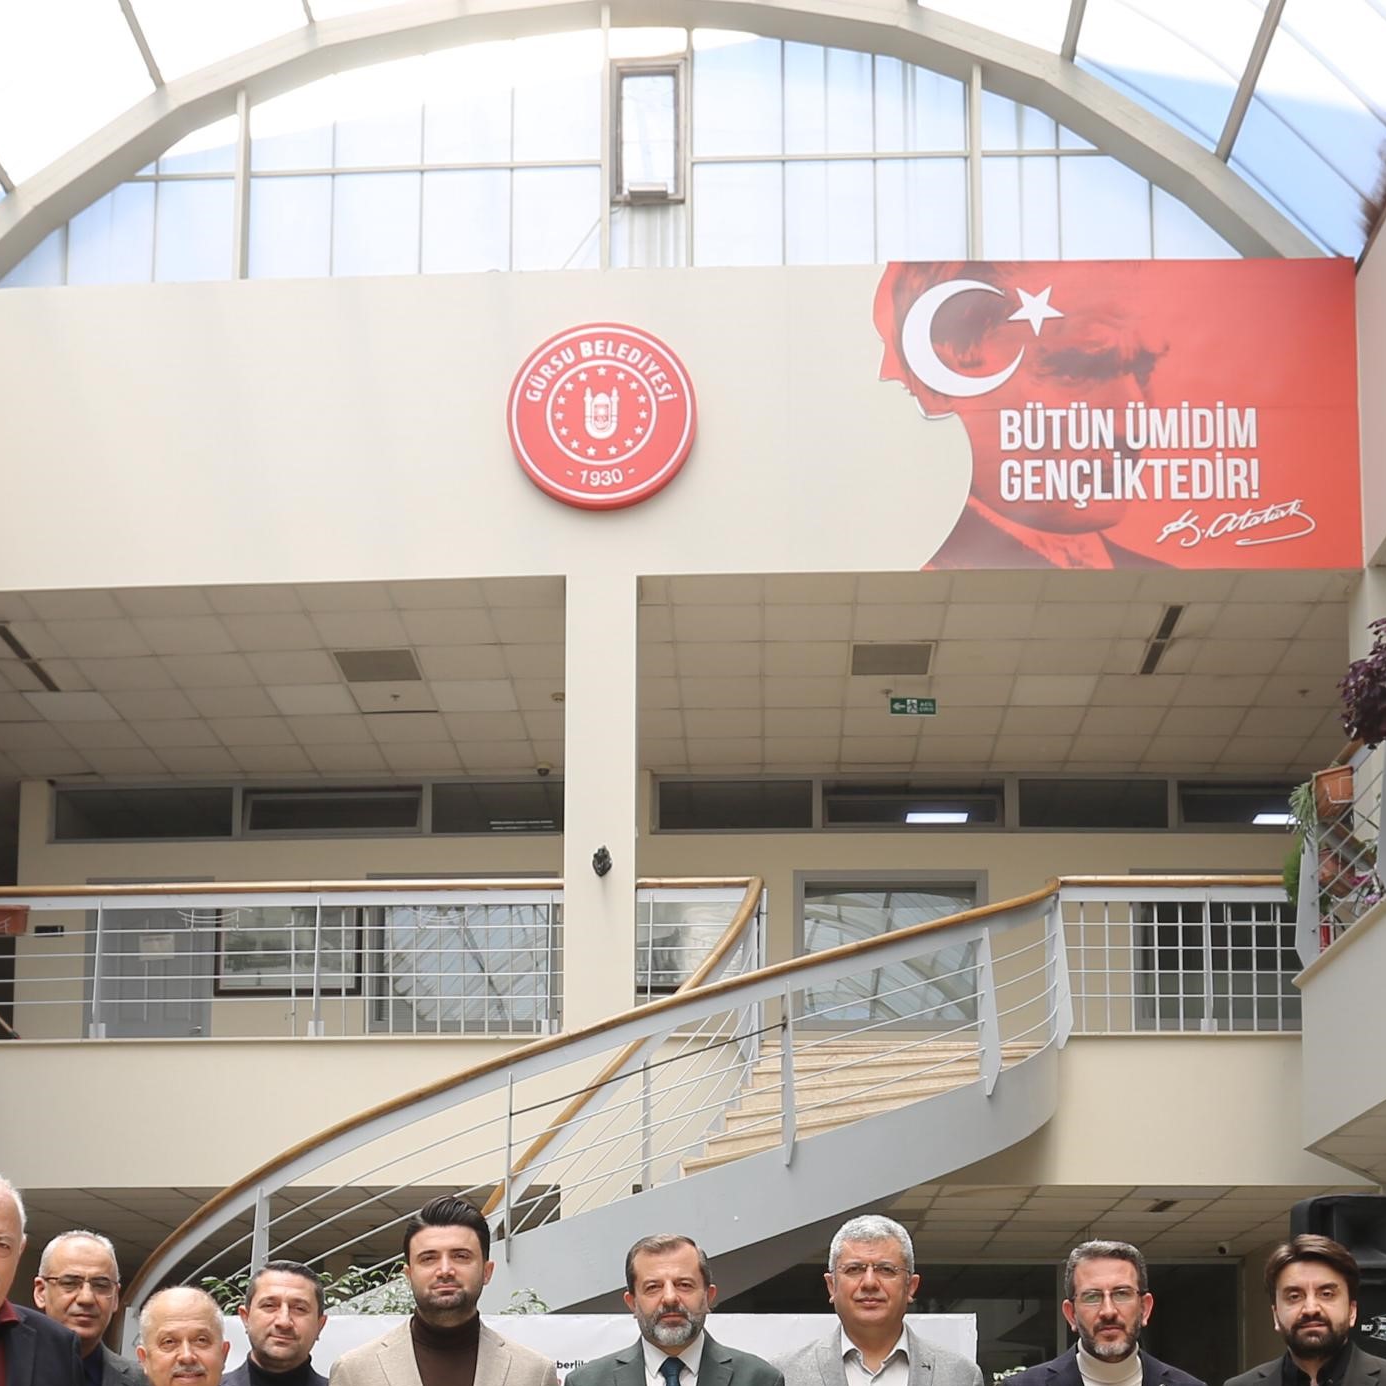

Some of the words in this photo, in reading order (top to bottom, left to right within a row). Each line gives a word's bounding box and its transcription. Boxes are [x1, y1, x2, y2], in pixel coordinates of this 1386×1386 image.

[525, 347, 576, 403] GÜRSU
[579, 339, 679, 403] BELEDİYESİ
[999, 401, 1115, 452] BÜTÜN
[1124, 400, 1258, 451] ÜMİDİM
[579, 467, 624, 487] 1930
[999, 452, 1260, 508] GENÇLİKTEDİR!
